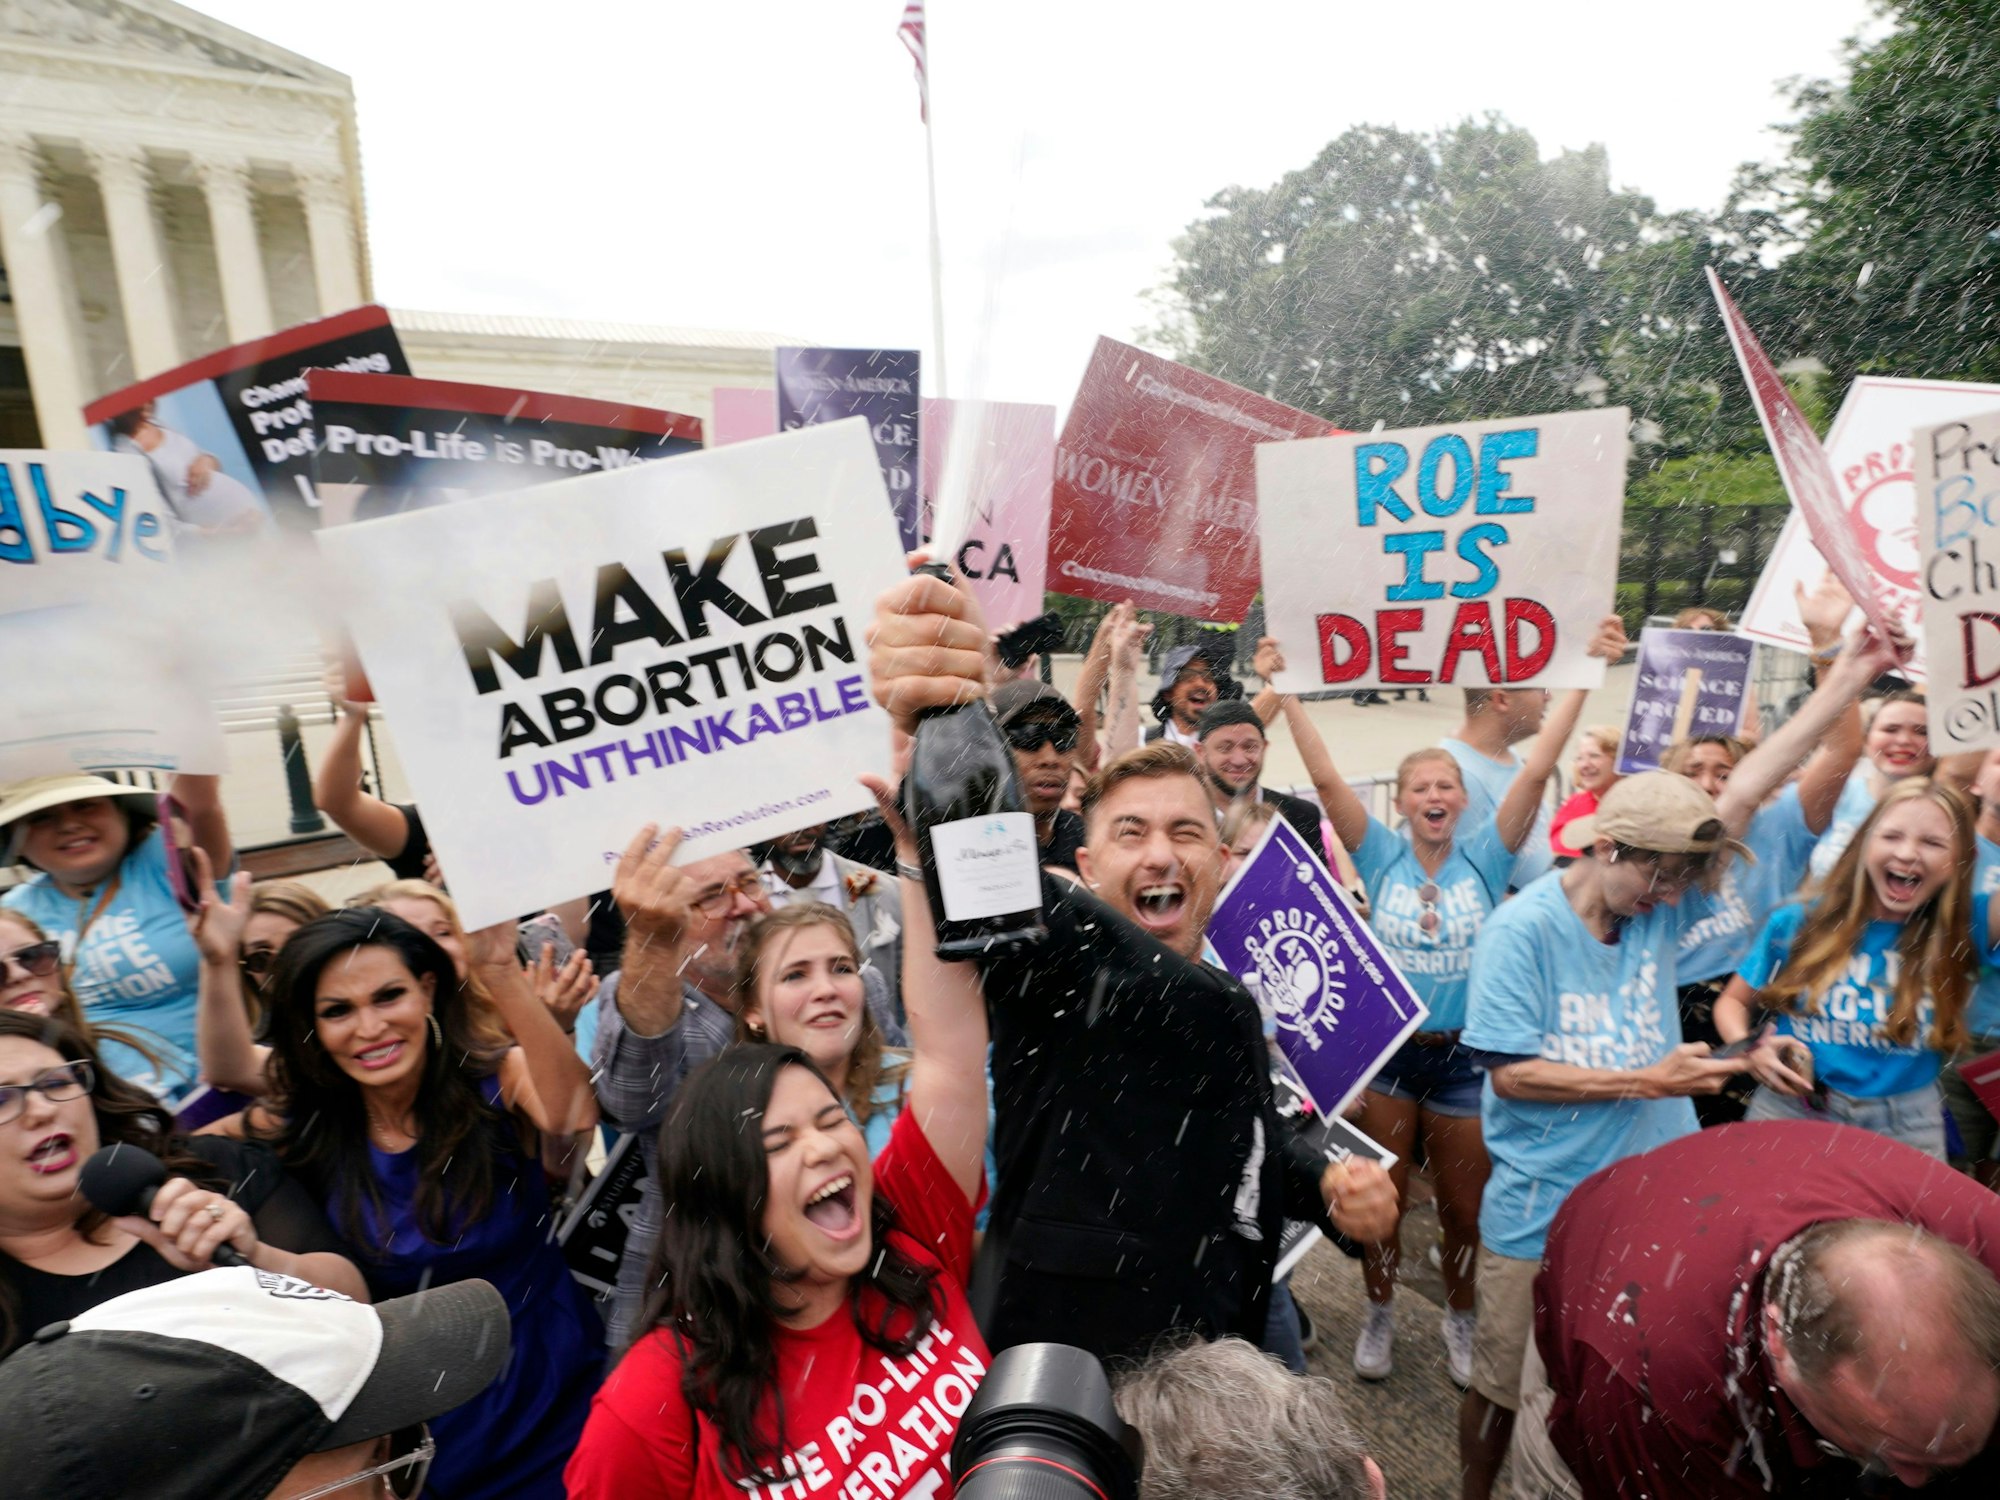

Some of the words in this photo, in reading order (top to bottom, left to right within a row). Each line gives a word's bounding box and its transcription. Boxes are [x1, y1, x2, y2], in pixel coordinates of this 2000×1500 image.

[325, 424, 487, 462] Pro-Life
[494, 434, 526, 464] is
[1354, 428, 1540, 527] ROE
[447, 515, 838, 695] MAKE
[1384, 522, 1509, 602] IS
[497, 616, 858, 759] ABORTION
[1316, 597, 1557, 685] DEAD
[504, 674, 871, 806] UNTHINKABLE
[1258, 907, 1348, 1033] PROTECTION
[1281, 937, 1309, 967] AT
[837, 1345, 987, 1500] ERATION
